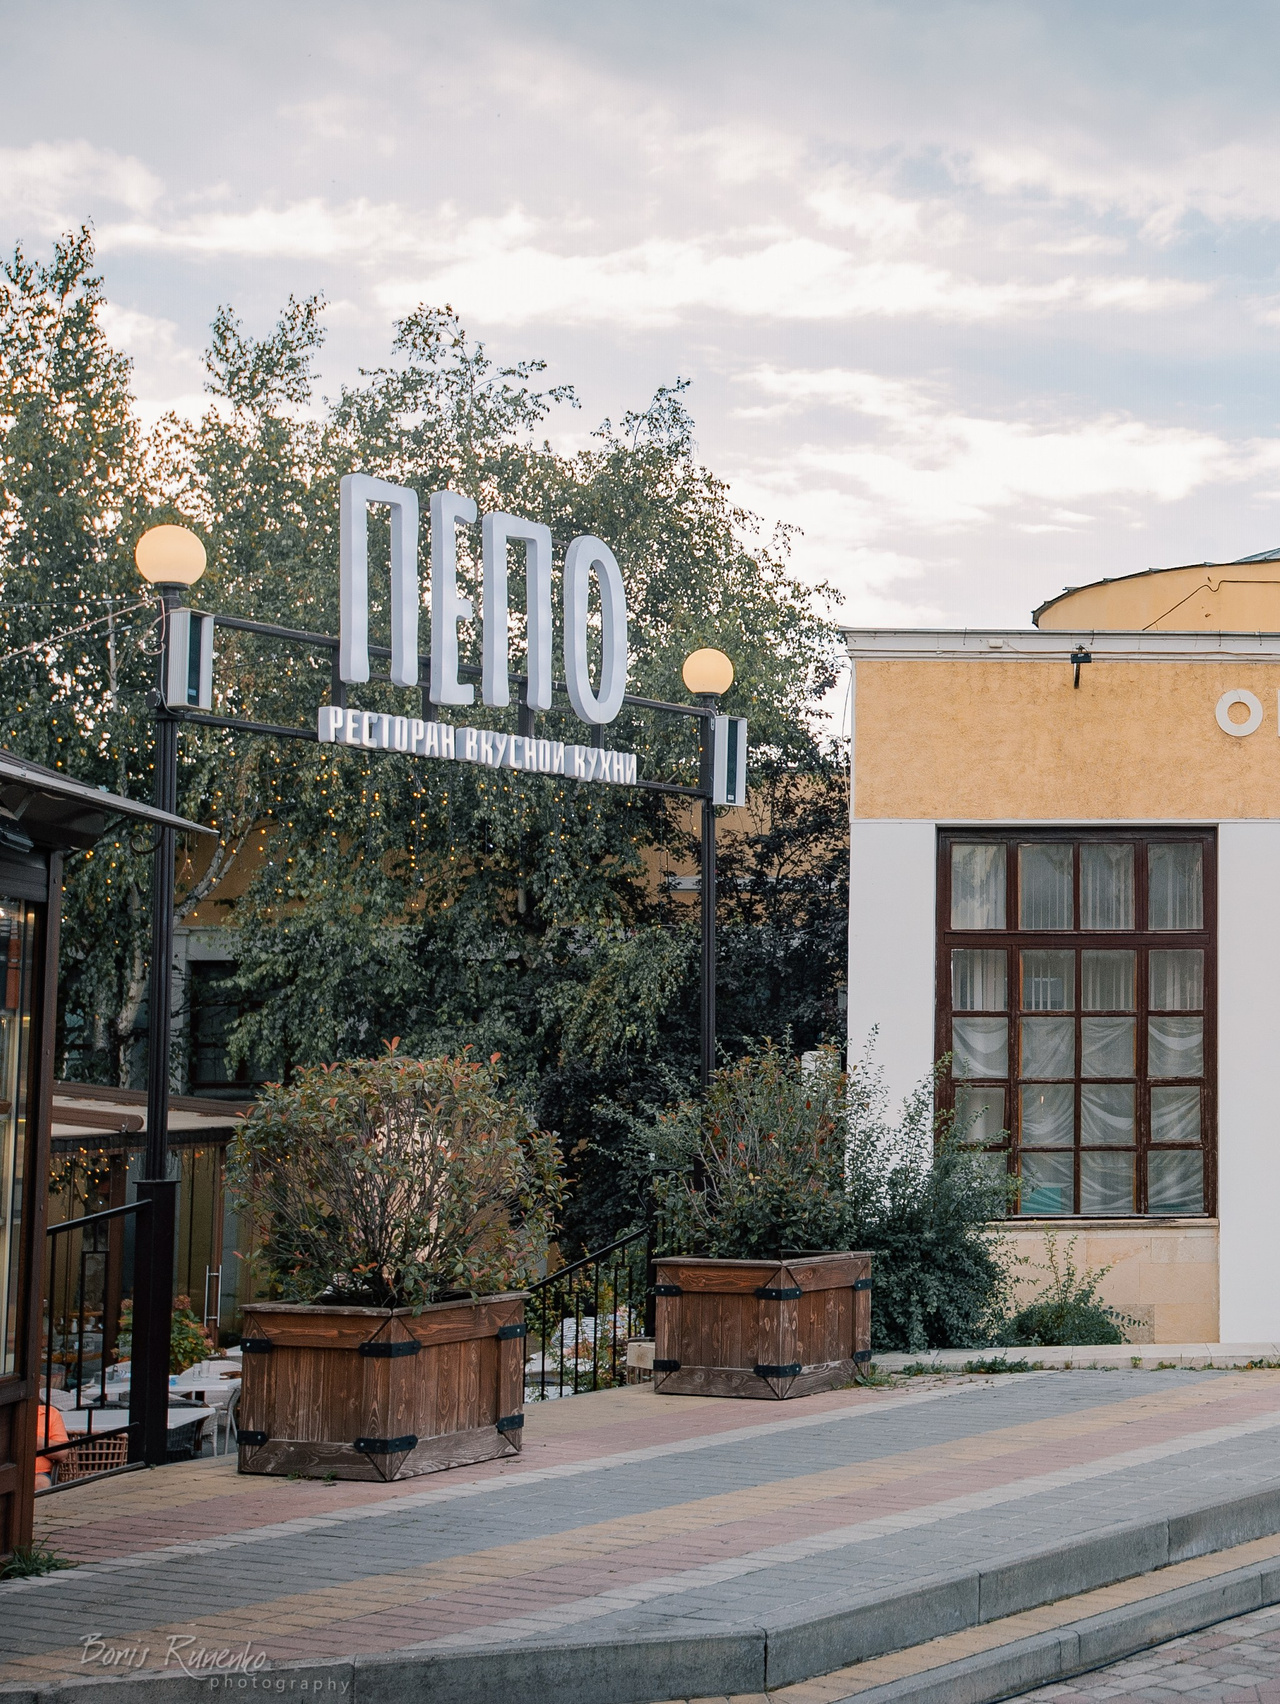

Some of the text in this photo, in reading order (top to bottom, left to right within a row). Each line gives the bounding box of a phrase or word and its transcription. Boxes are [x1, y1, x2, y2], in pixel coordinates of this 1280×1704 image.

[340, 473, 627, 724] ПЕПО
[318, 706, 455, 760] РЕСТОРАН
[564, 745, 637, 785] КУХНИ
